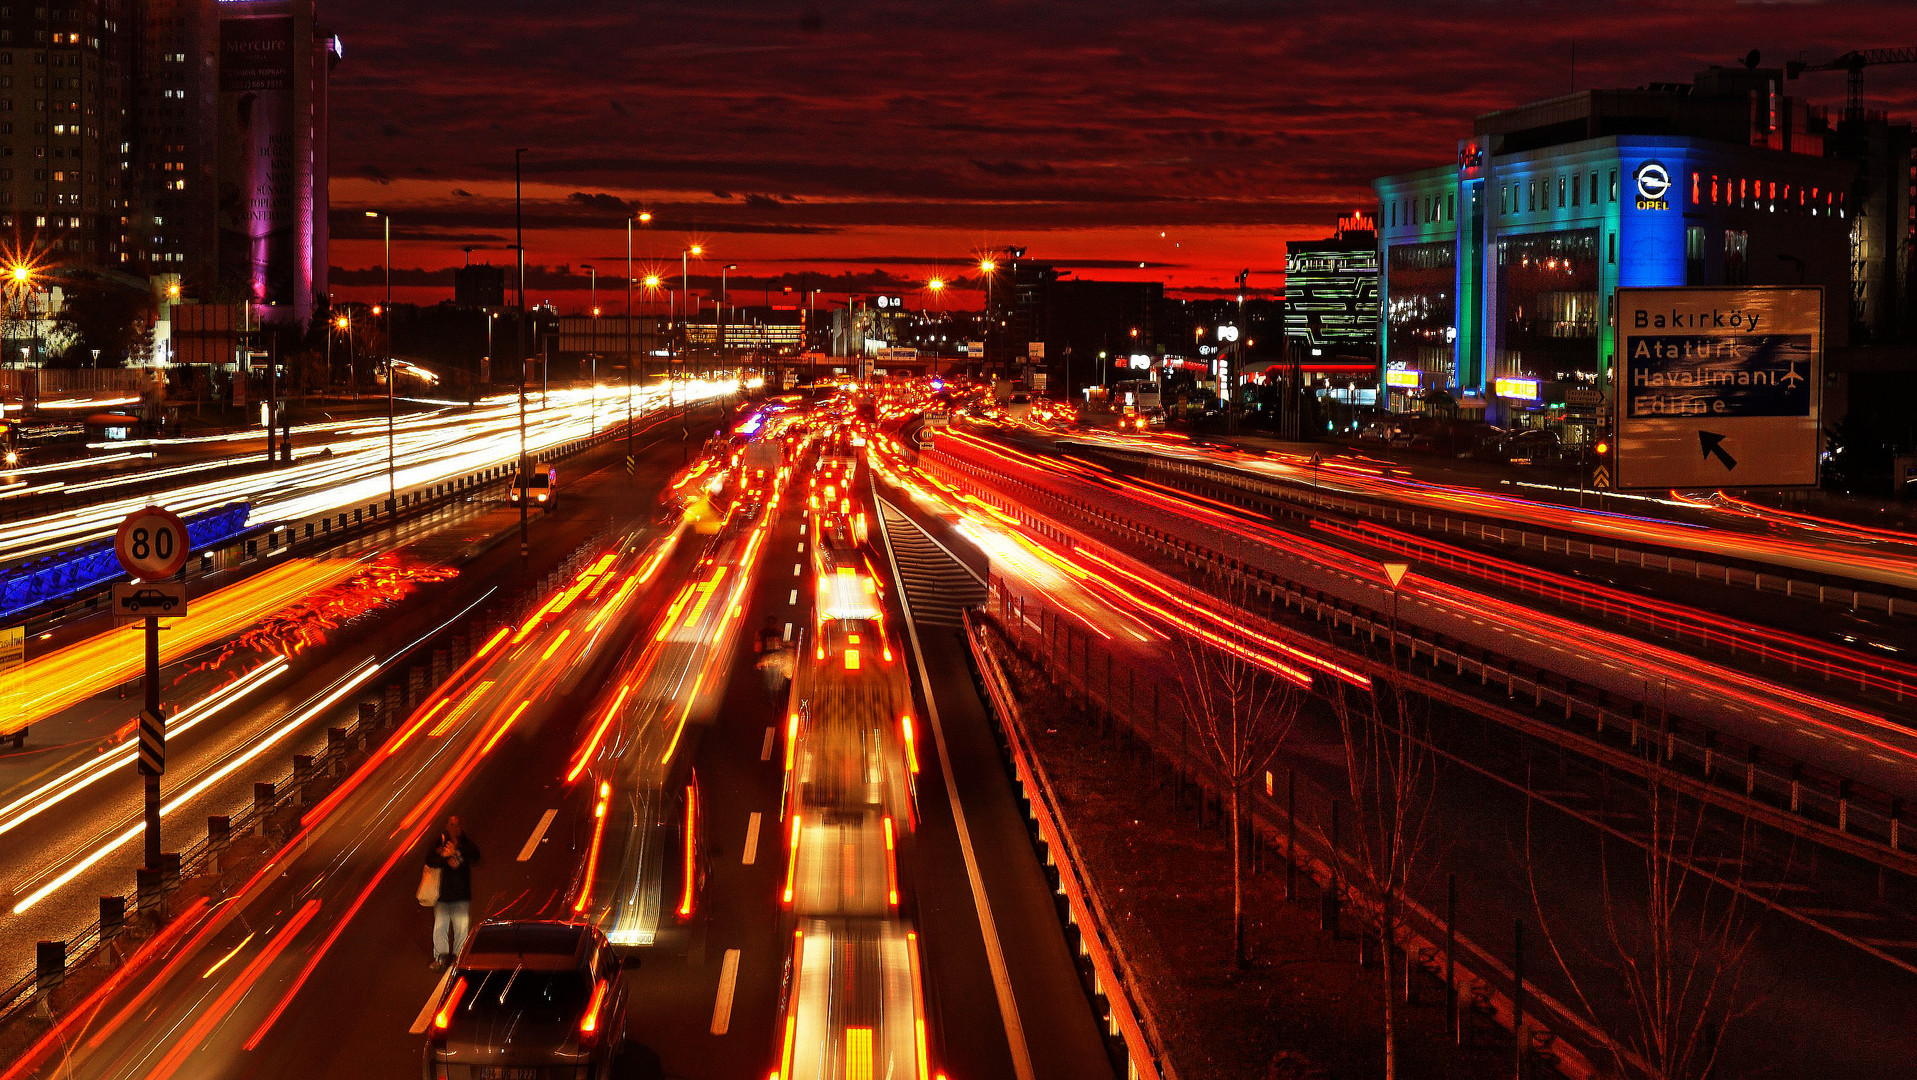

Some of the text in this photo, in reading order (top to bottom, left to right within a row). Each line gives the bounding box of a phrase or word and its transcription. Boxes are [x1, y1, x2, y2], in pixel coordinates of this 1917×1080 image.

[227, 39, 285, 52] Mercure
[1637, 201, 1670, 211] OPEL
[1634, 308, 1760, 332] Bakırköy
[1634, 339, 1742, 359] Atatürk
[1634, 366, 1776, 387] Havalimanı
[1634, 395, 1727, 414] Edirne
[132, 527, 173, 560] 80
